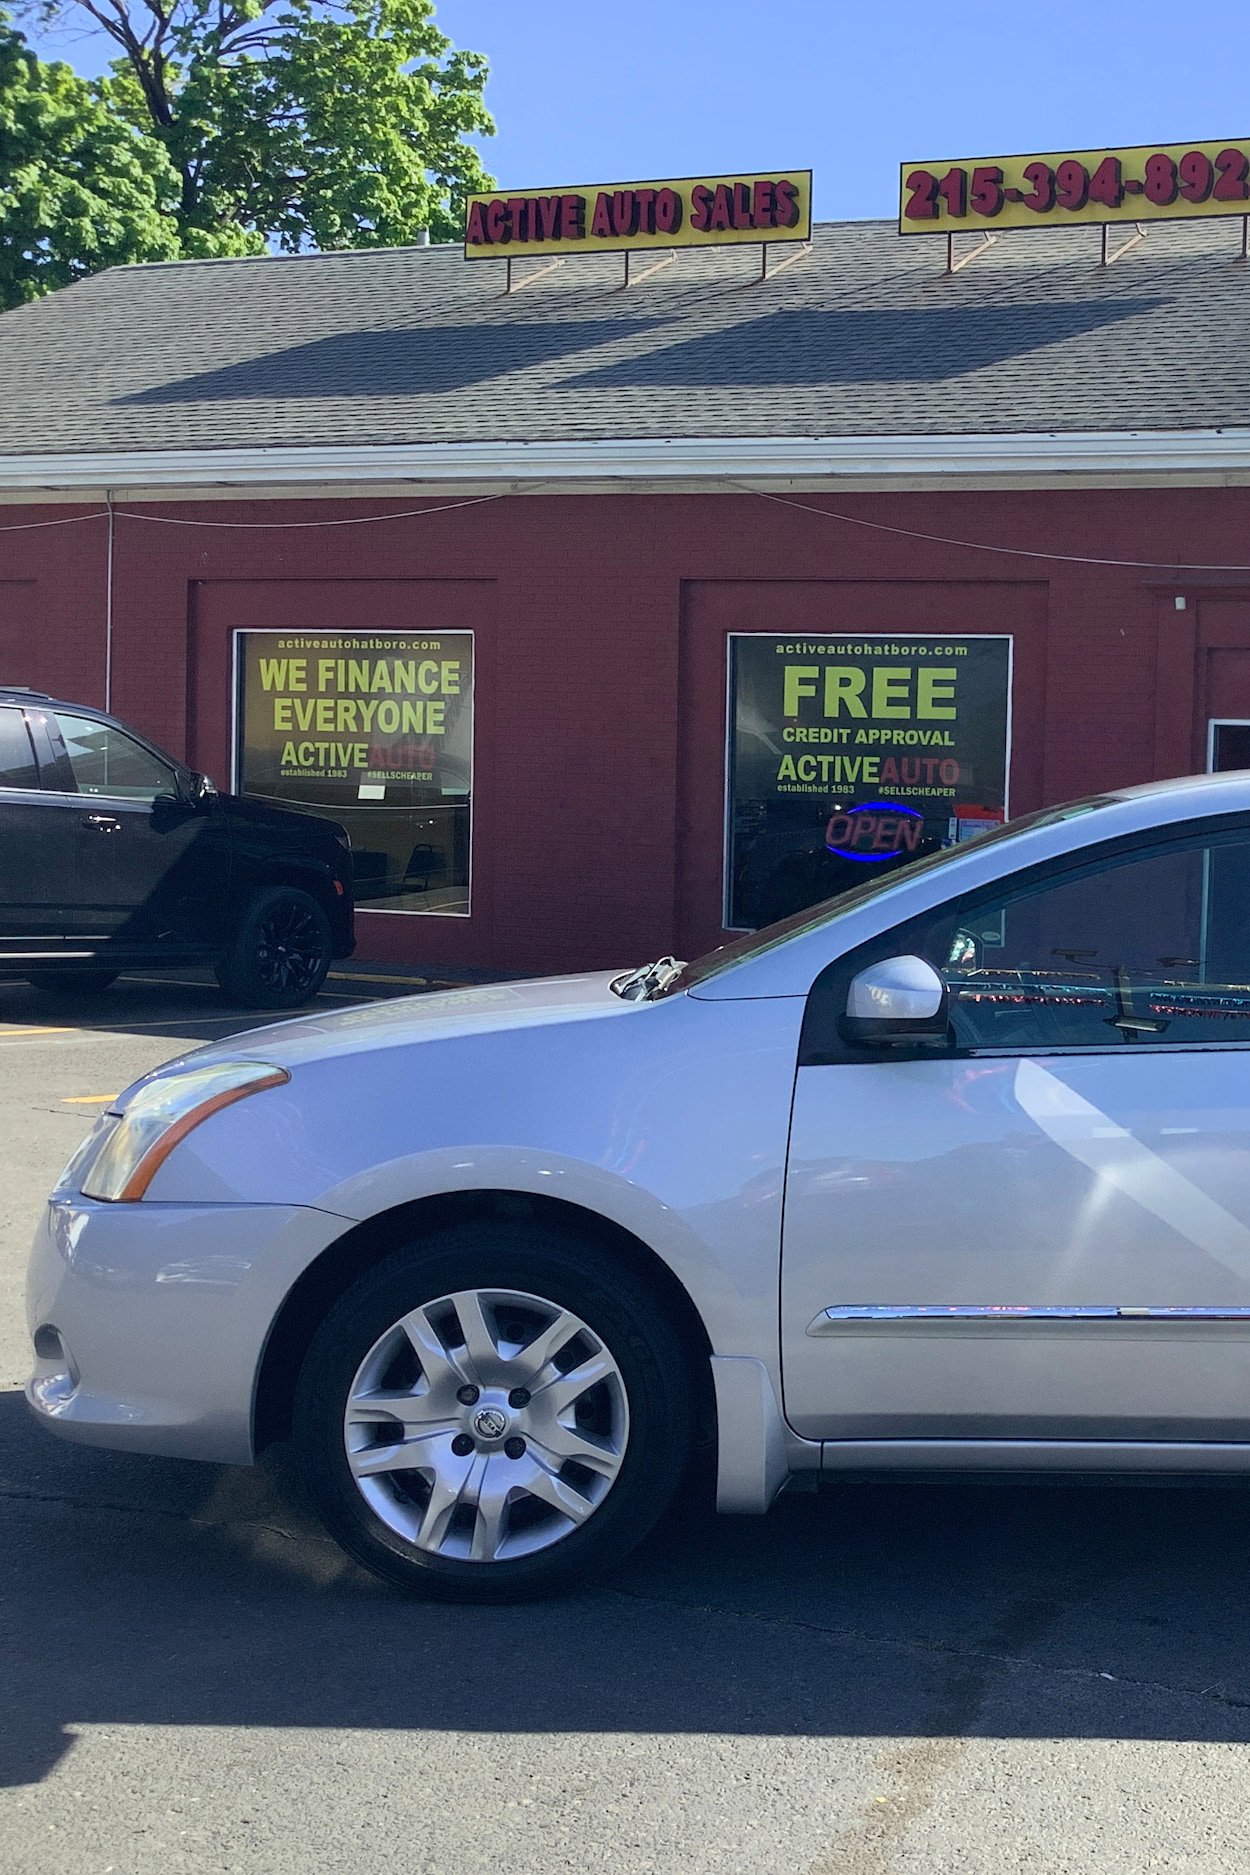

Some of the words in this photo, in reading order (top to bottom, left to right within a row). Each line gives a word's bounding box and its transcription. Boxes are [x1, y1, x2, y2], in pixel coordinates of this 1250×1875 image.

[466, 195, 586, 244] ACTIVE
[591, 187, 682, 237] AUTO
[690, 180, 799, 232] SALES
[278, 638, 441, 650] activeautohatboro.com
[775, 643, 968, 656] activeautohatboro.com
[259, 658, 307, 692] WE
[318, 659, 460, 695] FINANCE
[783, 666, 957, 720] FREE
[274, 698, 445, 735] EVERYONE
[782, 727, 851, 743] CREDIT
[855, 729, 955, 746] APPROVAL
[280, 769, 325, 778] established
[327, 769, 347, 778] 1983
[777, 784, 829, 794] established
[831, 785, 855, 794] 1983
[878, 786, 956, 797] #SELLSCHEAPER
[825, 814, 924, 851] OPEN
